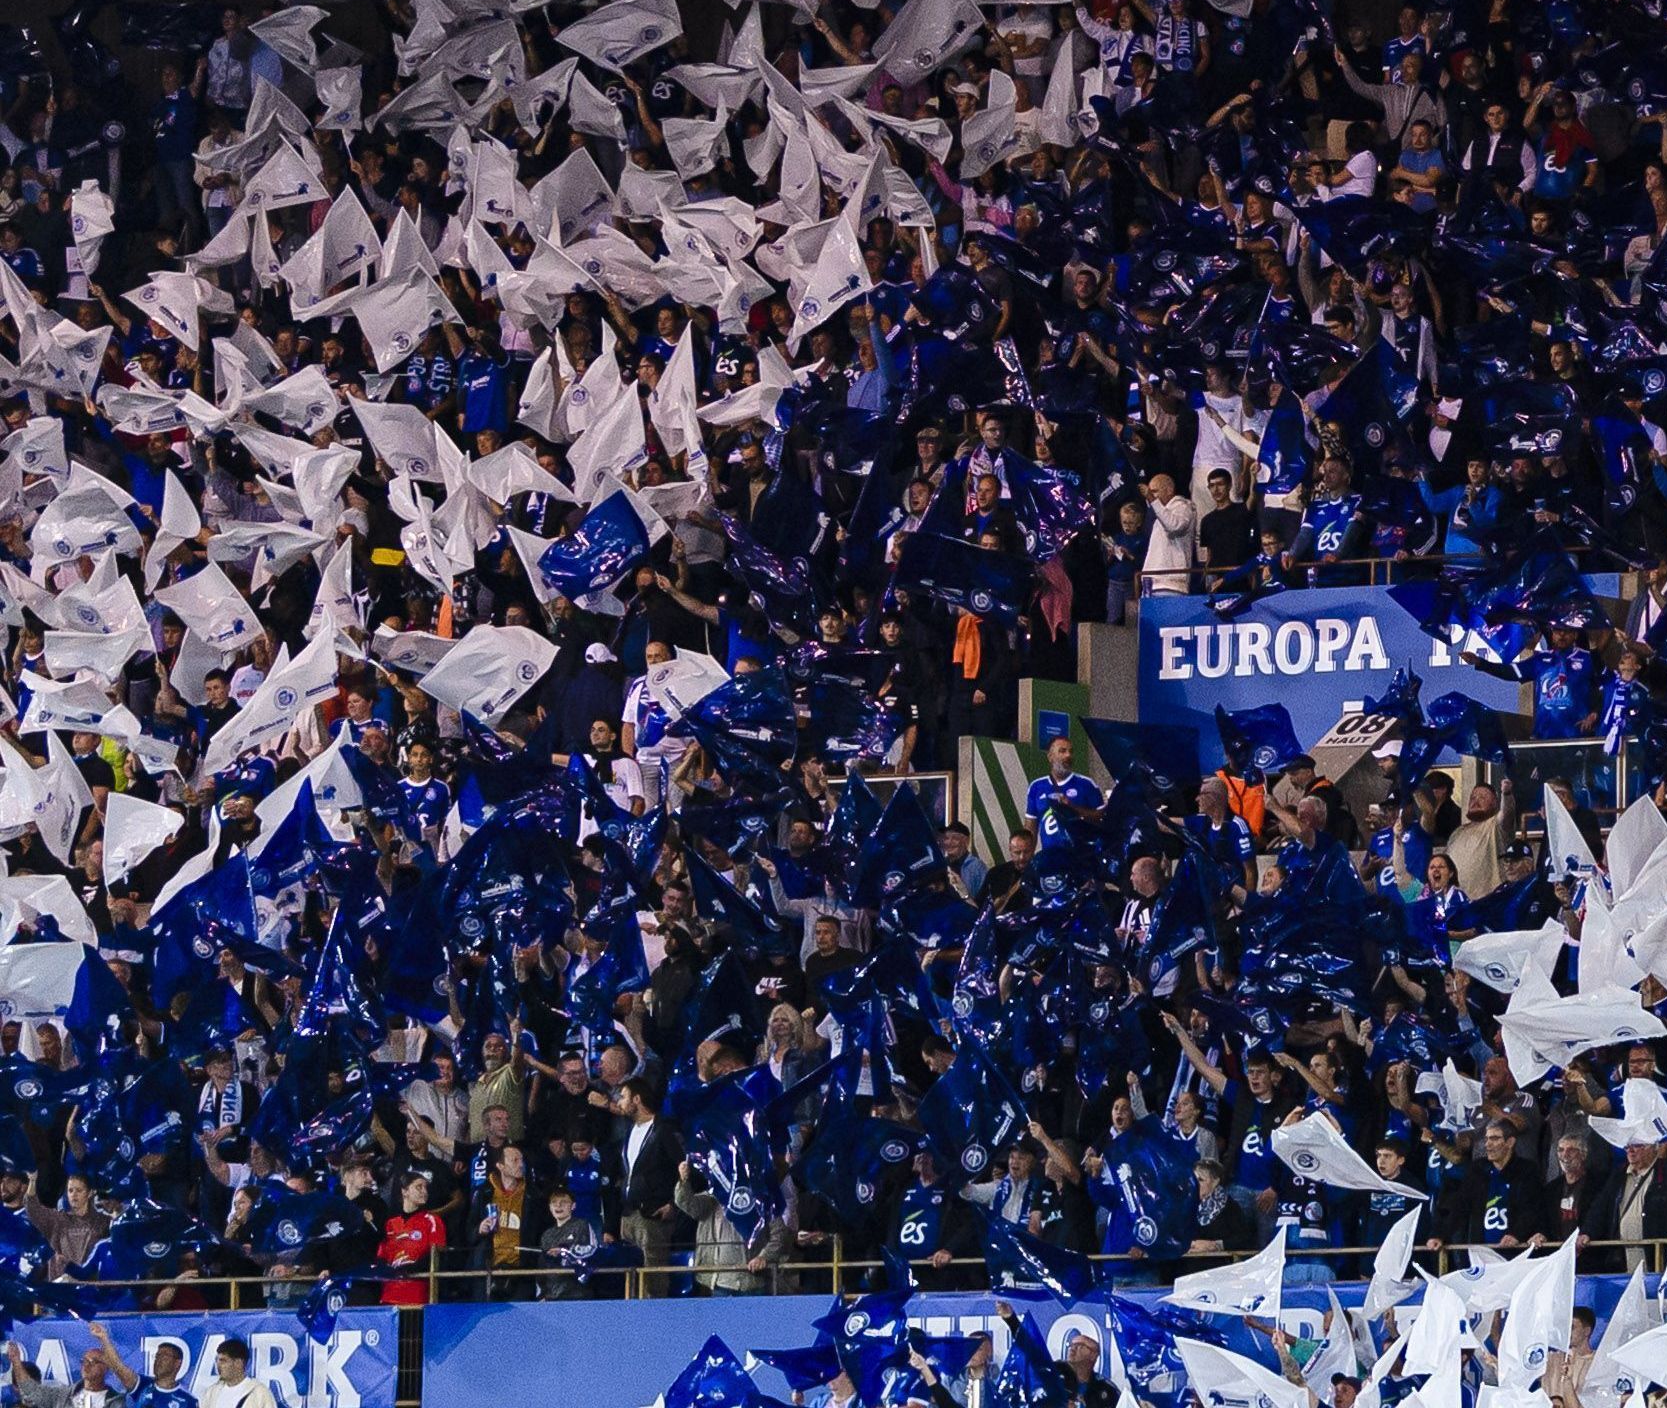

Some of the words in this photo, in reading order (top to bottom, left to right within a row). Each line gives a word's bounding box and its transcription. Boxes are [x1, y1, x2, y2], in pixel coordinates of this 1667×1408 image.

[1158, 616, 1391, 681] EUROPA
[1336, 713, 1387, 737] 08
[1325, 735, 1374, 745] HAUT
